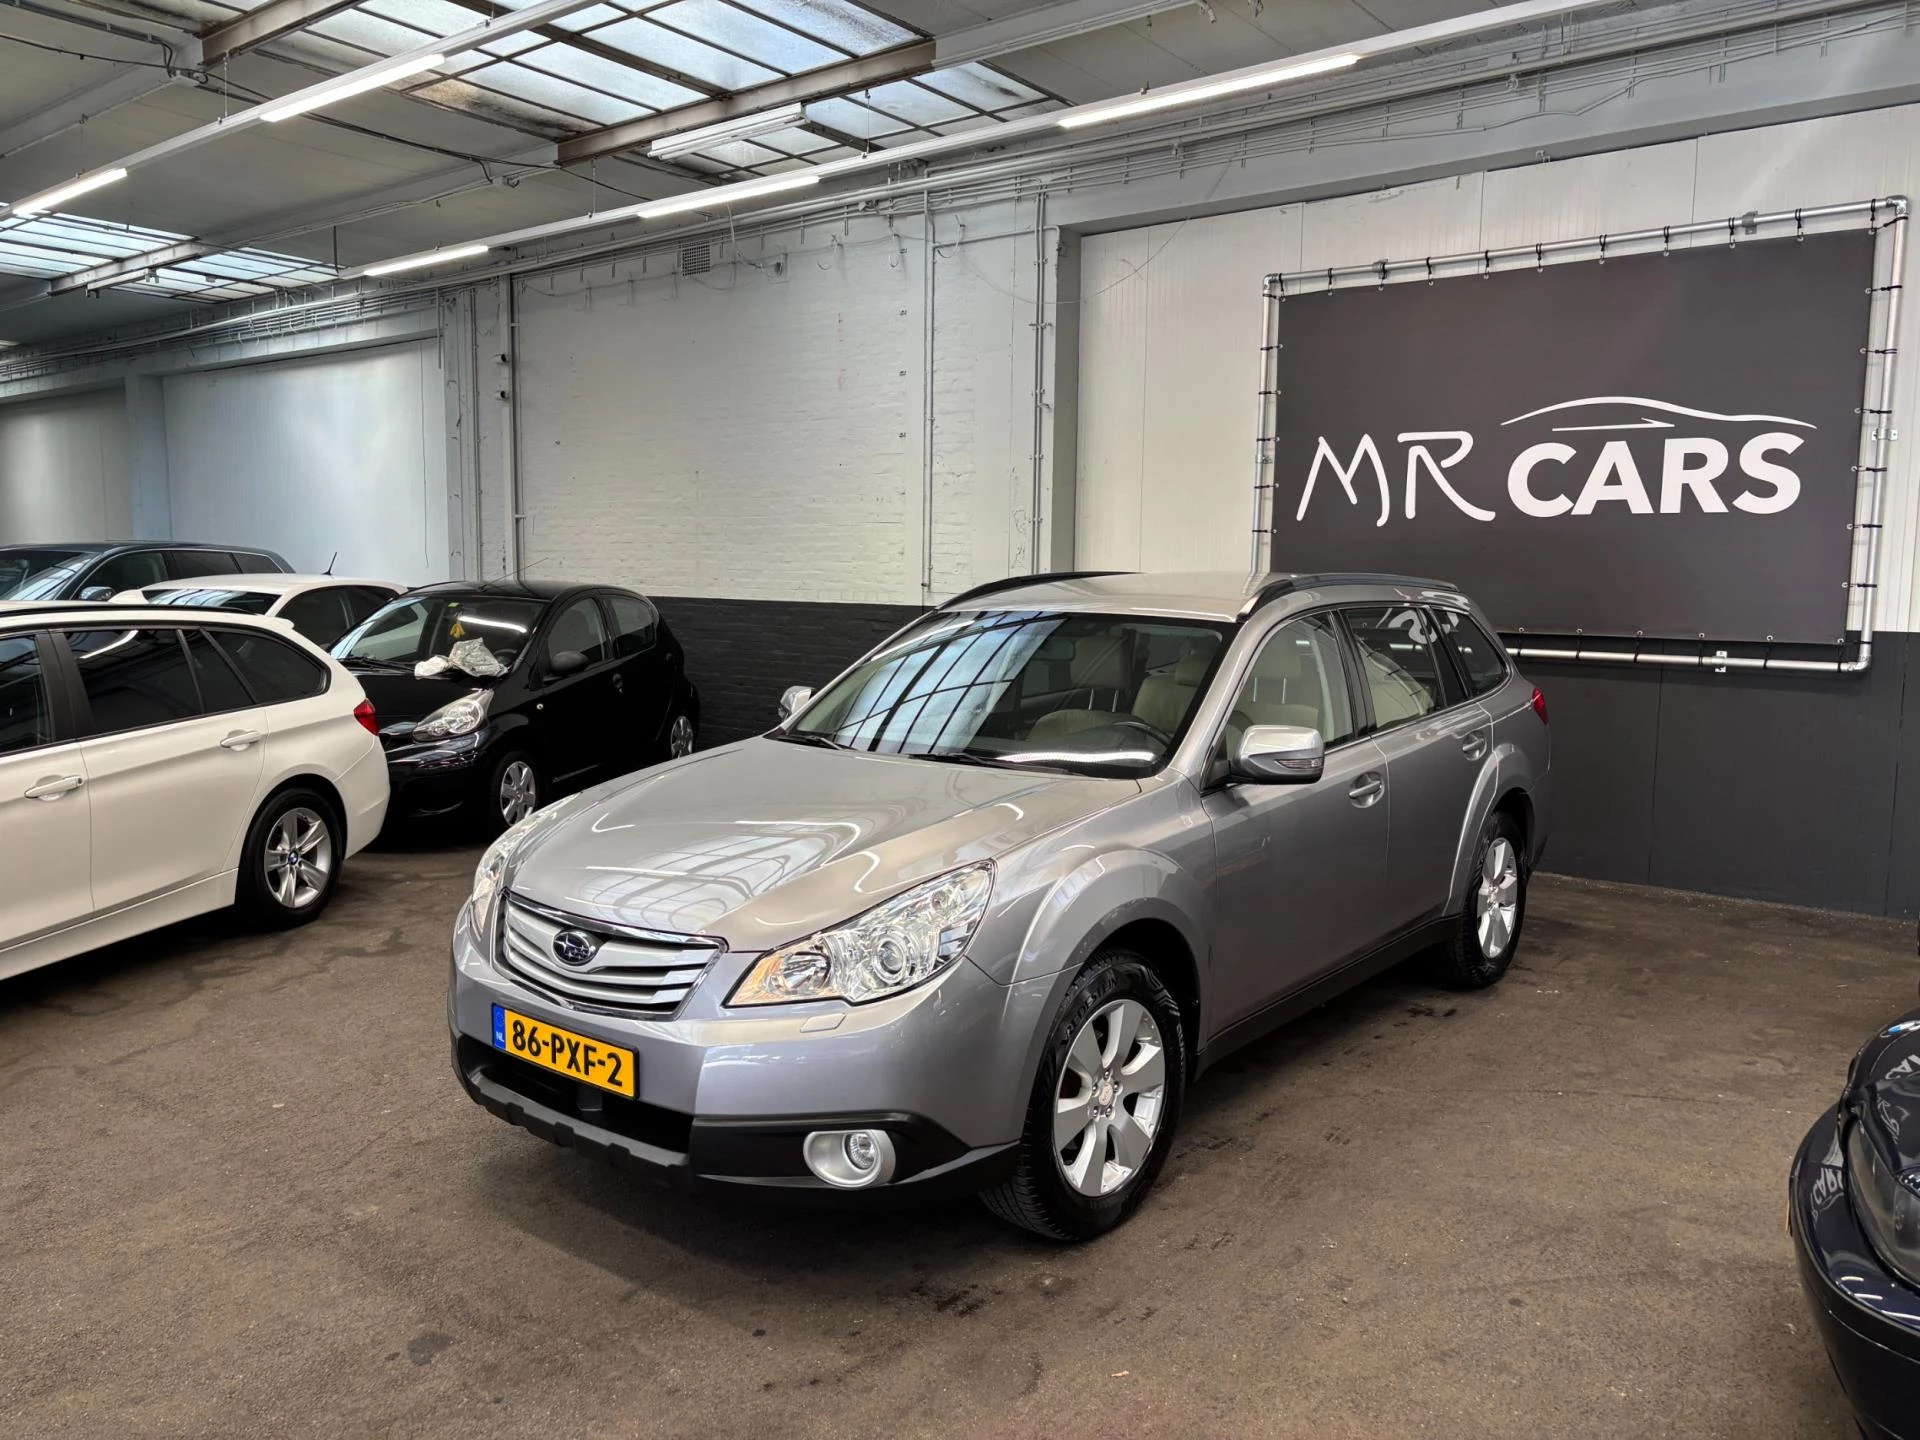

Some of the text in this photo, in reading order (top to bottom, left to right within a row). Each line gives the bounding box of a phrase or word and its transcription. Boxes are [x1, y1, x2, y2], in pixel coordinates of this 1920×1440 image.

[1296, 430, 1805, 528] MR CARS
[495, 1030, 505, 1043] NL
[512, 1019, 623, 1087] 86-PXF-2
